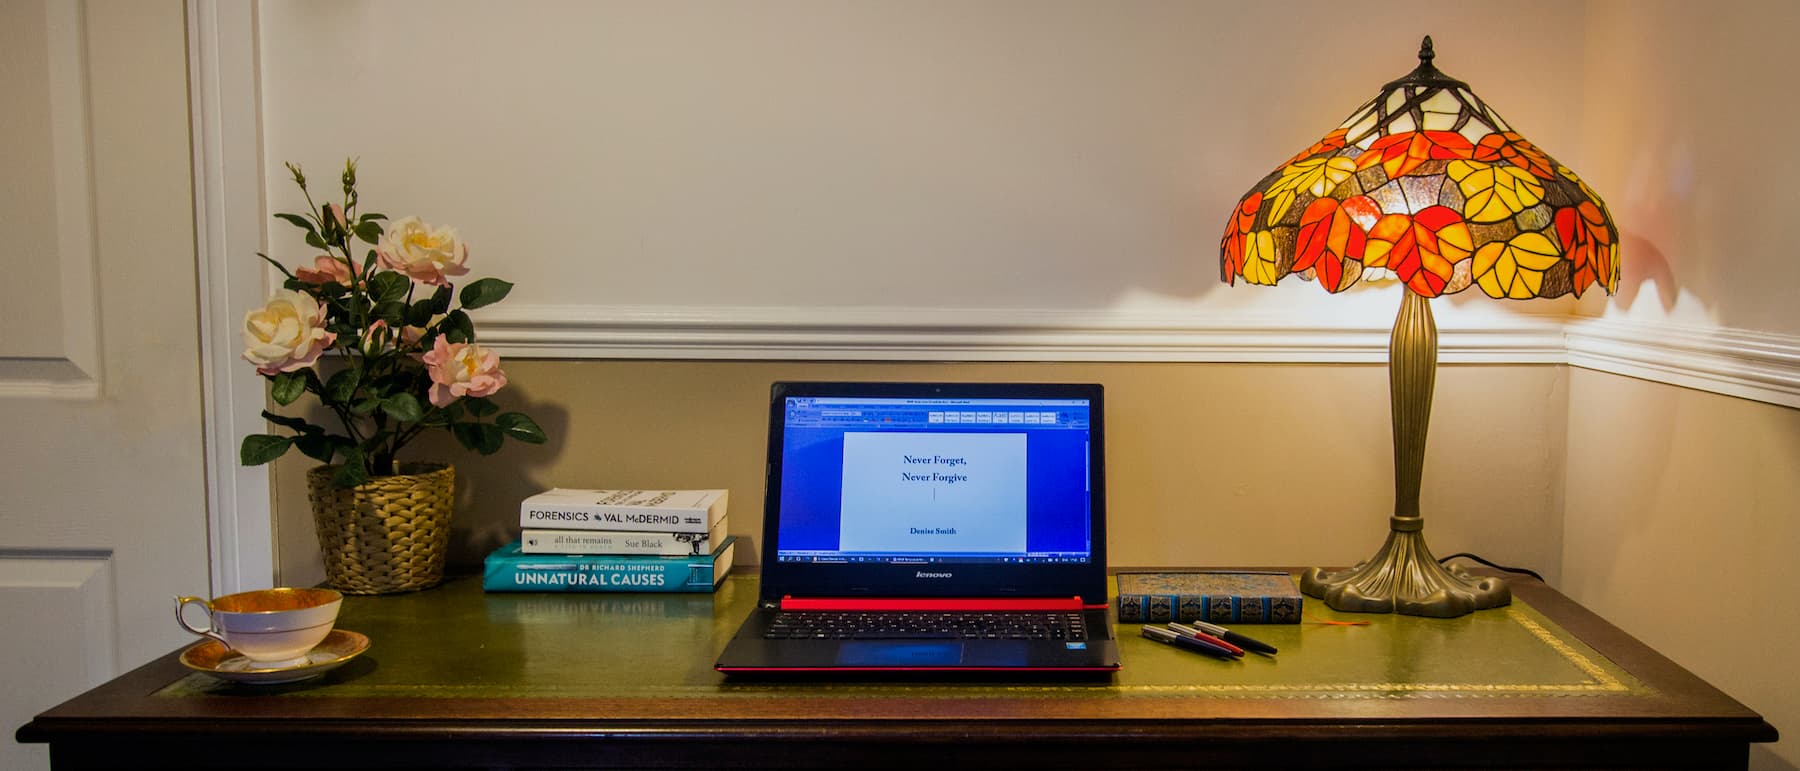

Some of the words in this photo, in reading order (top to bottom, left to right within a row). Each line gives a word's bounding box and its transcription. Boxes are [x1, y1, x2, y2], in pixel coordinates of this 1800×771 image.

[903, 455, 931, 464] Never
[934, 455, 967, 467] Forget,
[902, 472, 930, 481] Never
[932, 472, 968, 484] Forgive
[529, 511, 589, 521] FORENSICS
[604, 513, 623, 523] VAL
[626, 514, 679, 524] McDERMID
[910, 527, 934, 535] Denise
[935, 527, 957, 535] Smith
[554, 536, 564, 544] all
[565, 536, 581, 545] that
[583, 536, 612, 545] remains
[625, 540, 639, 548] Sue
[641, 540, 663, 549] Black
[515, 572, 608, 585] UNNATURAL
[611, 573, 665, 586] CAUSES
[916, 571, 952, 579] lenovo
